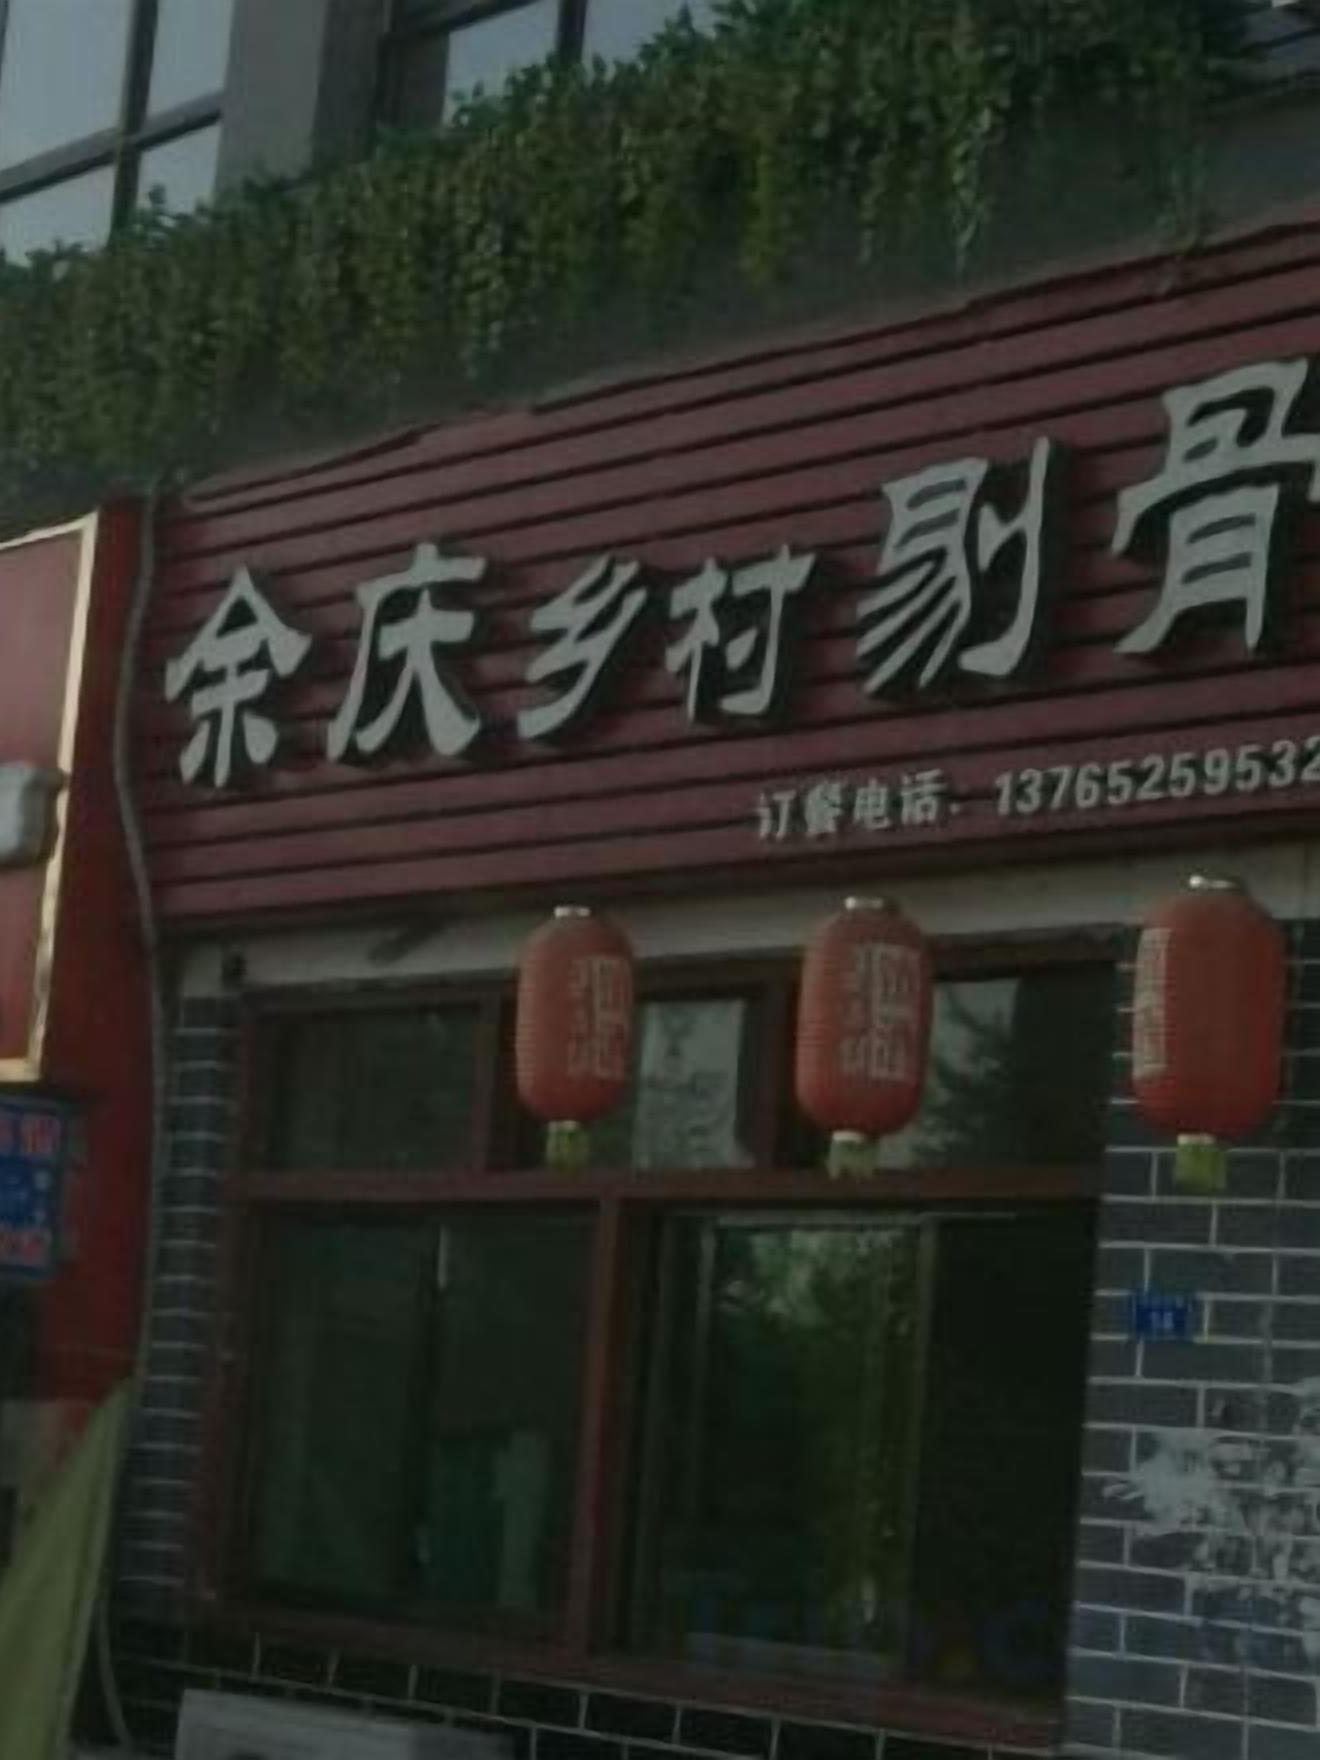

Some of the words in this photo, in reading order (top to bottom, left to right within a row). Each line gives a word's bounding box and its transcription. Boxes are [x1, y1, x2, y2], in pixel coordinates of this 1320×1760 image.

[164, 357, 1320, 787] 余庆乡村剔骨
[995, 737, 1320, 816] 13765259532
